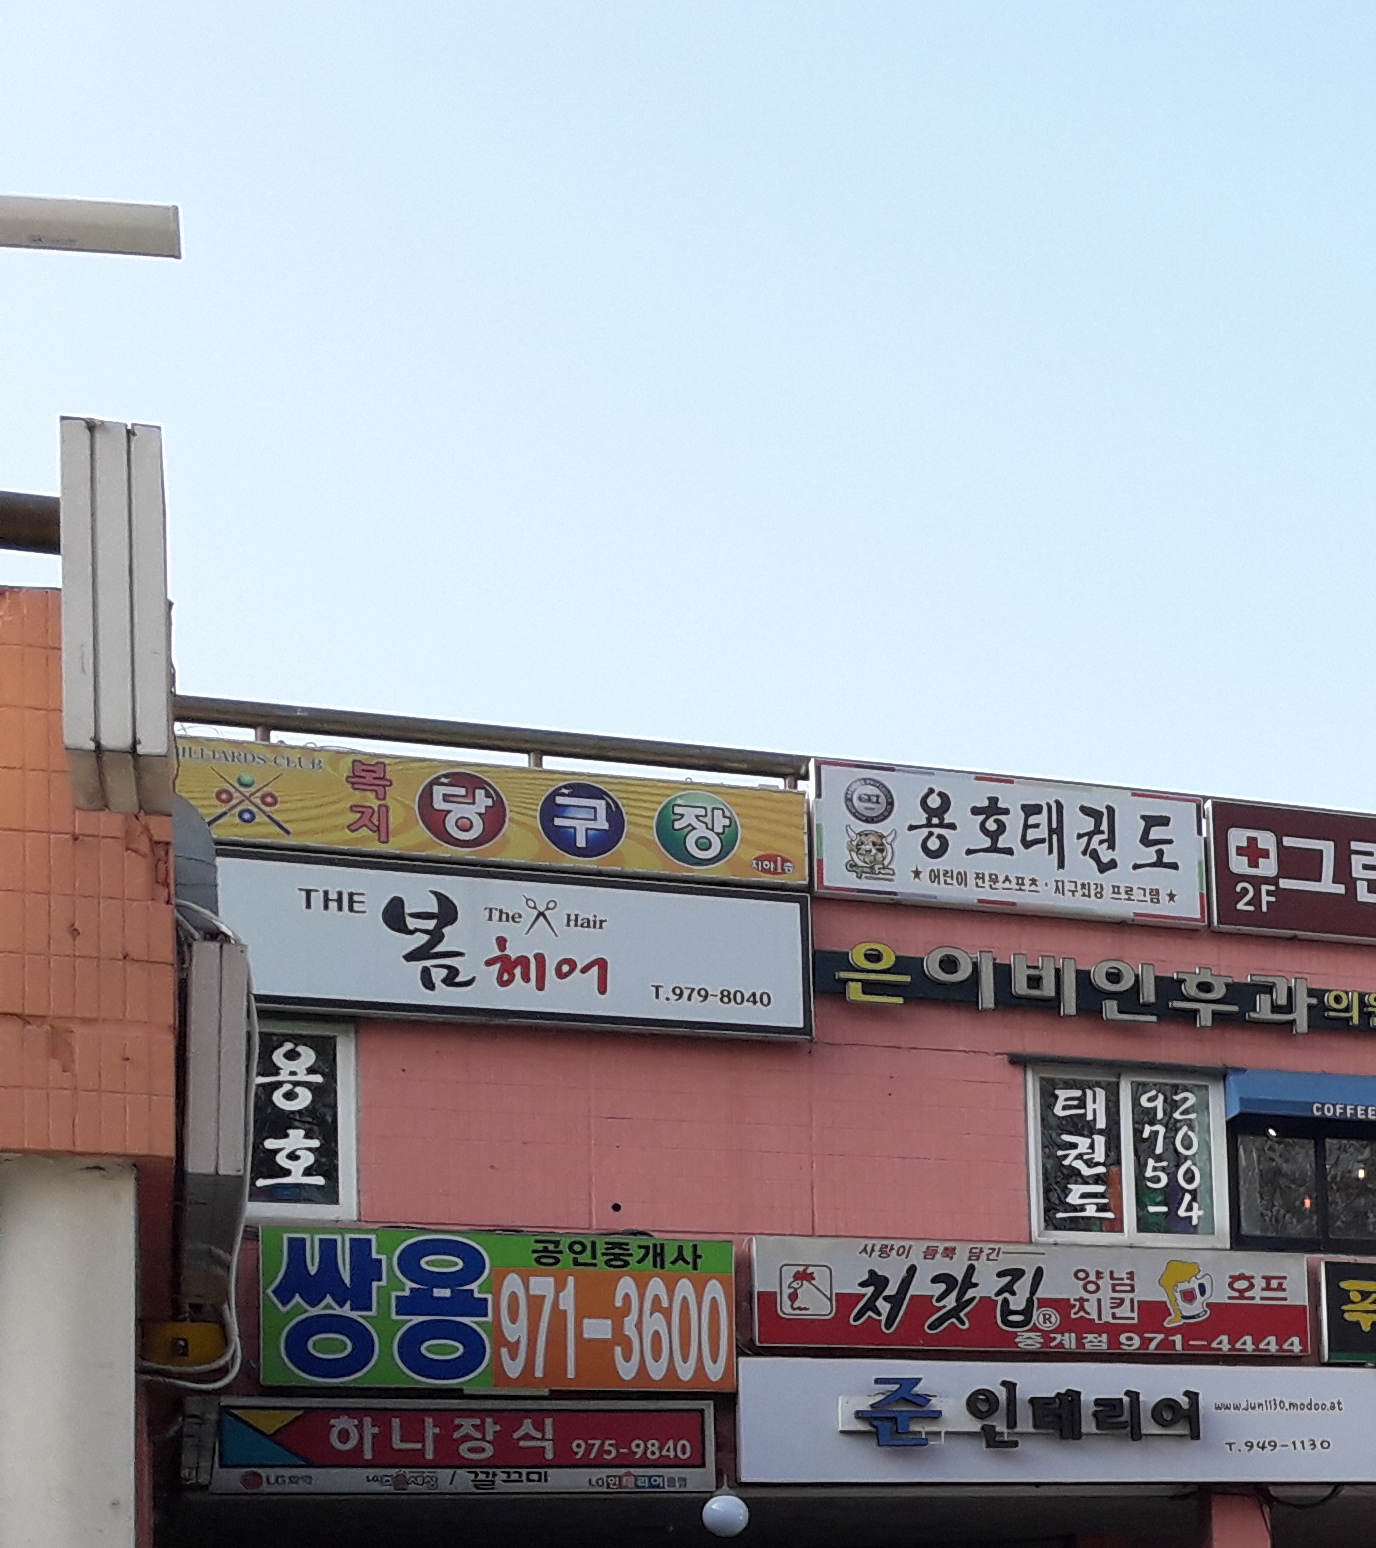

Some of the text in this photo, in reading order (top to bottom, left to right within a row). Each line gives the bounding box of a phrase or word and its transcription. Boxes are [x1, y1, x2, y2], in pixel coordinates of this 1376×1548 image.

[177, 746, 324, 771] ILLIARDS CLUB
[346, 759, 393, 844] 복지
[431, 783, 732, 861] 당구장
[907, 786, 1180, 874] 용호태권도
[928, 868, 968, 888] 어린이
[1235, 881, 1277, 912] 2F
[298, 887, 367, 915] THE
[483, 906, 608, 934] The Hair
[382, 889, 477, 990] 봄
[483, 934, 610, 995] 헤어
[254, 1040, 327, 1188] 용호
[1052, 1085, 1117, 1222] 태권도
[530, 1238, 704, 1272] 공인중개사
[858, 1244, 913, 1260] 사랑이
[967, 1246, 1002, 1263] 담긴
[849, 1263, 1045, 1333] 처갓집
[1072, 1267, 1137, 1295] 양념
[1227, 1271, 1289, 1303] 호프
[266, 1233, 493, 1383] 쌍용
[499, 1272, 730, 1382] 971-3600
[1070, 1296, 1139, 1324] 치킨
[1014, 1331, 1303, 1354] 중계점 971-4444
[855, 1376, 1202, 1449] 준 인테리어
[328, 1415, 692, 1462] 하나장식 975-9840
[1224, 1438, 1332, 1453] T.949-1130
